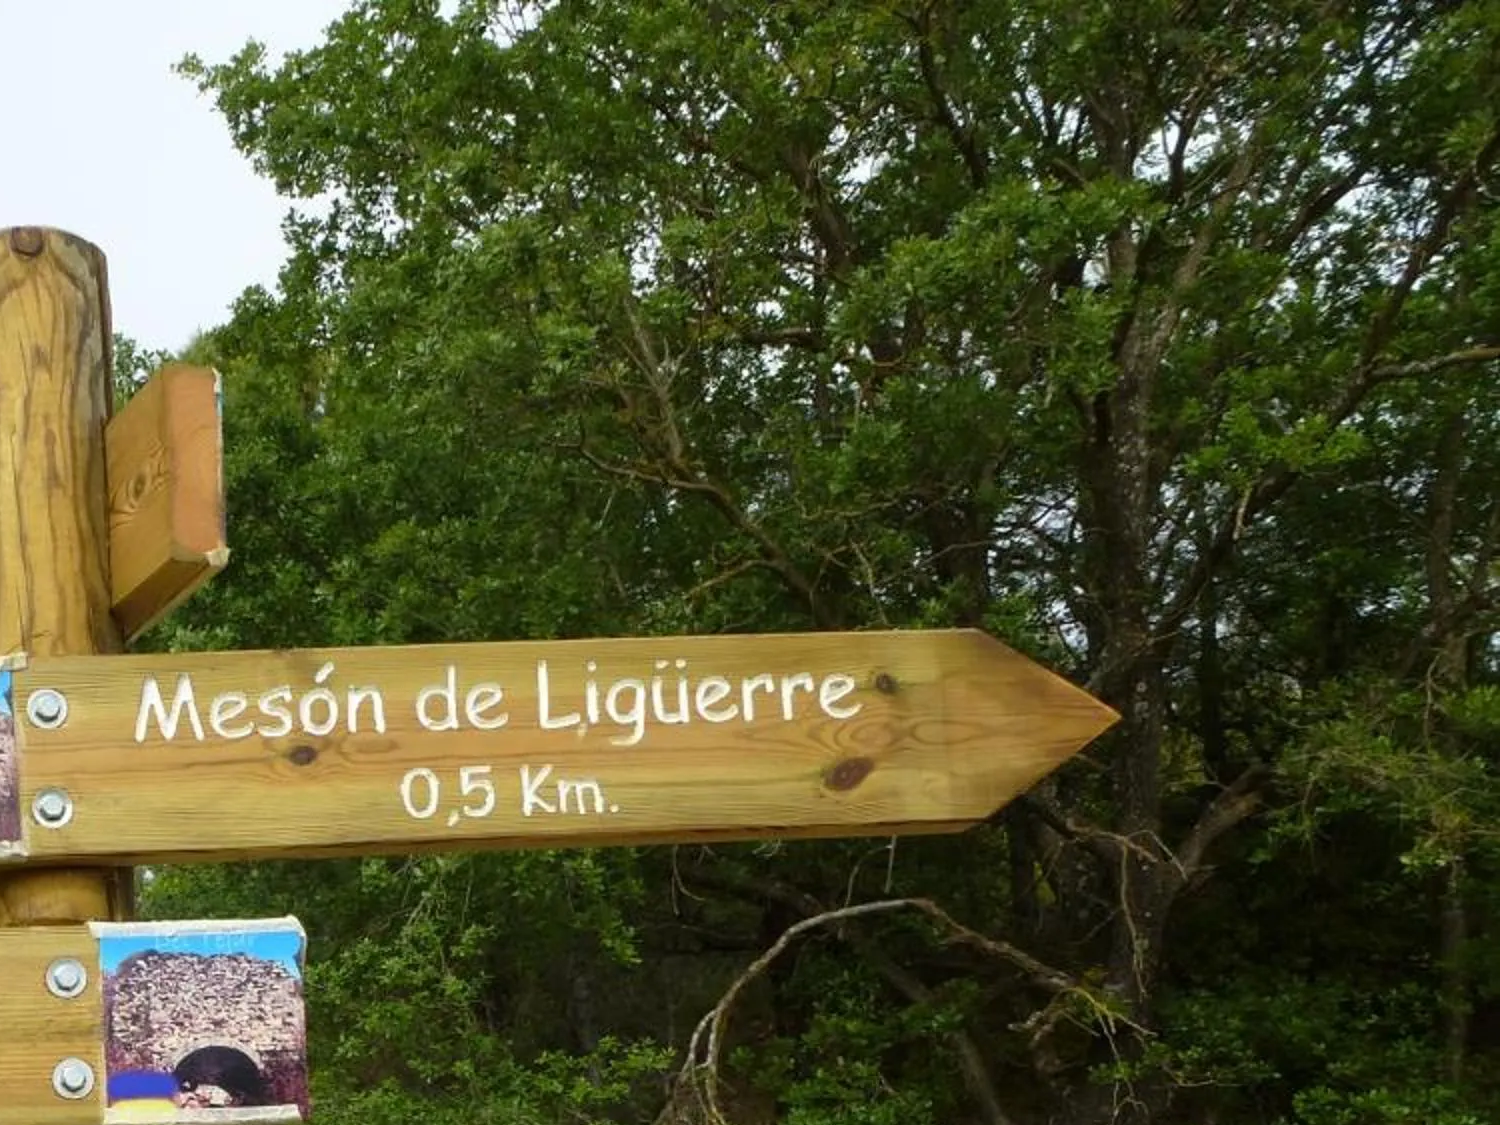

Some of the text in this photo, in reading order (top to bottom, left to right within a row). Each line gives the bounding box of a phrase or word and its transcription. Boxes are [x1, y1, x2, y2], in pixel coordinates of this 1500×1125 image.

[132, 658, 861, 746] Mesón de Ligüerre
[398, 764, 621, 828] 0,5 Km.
